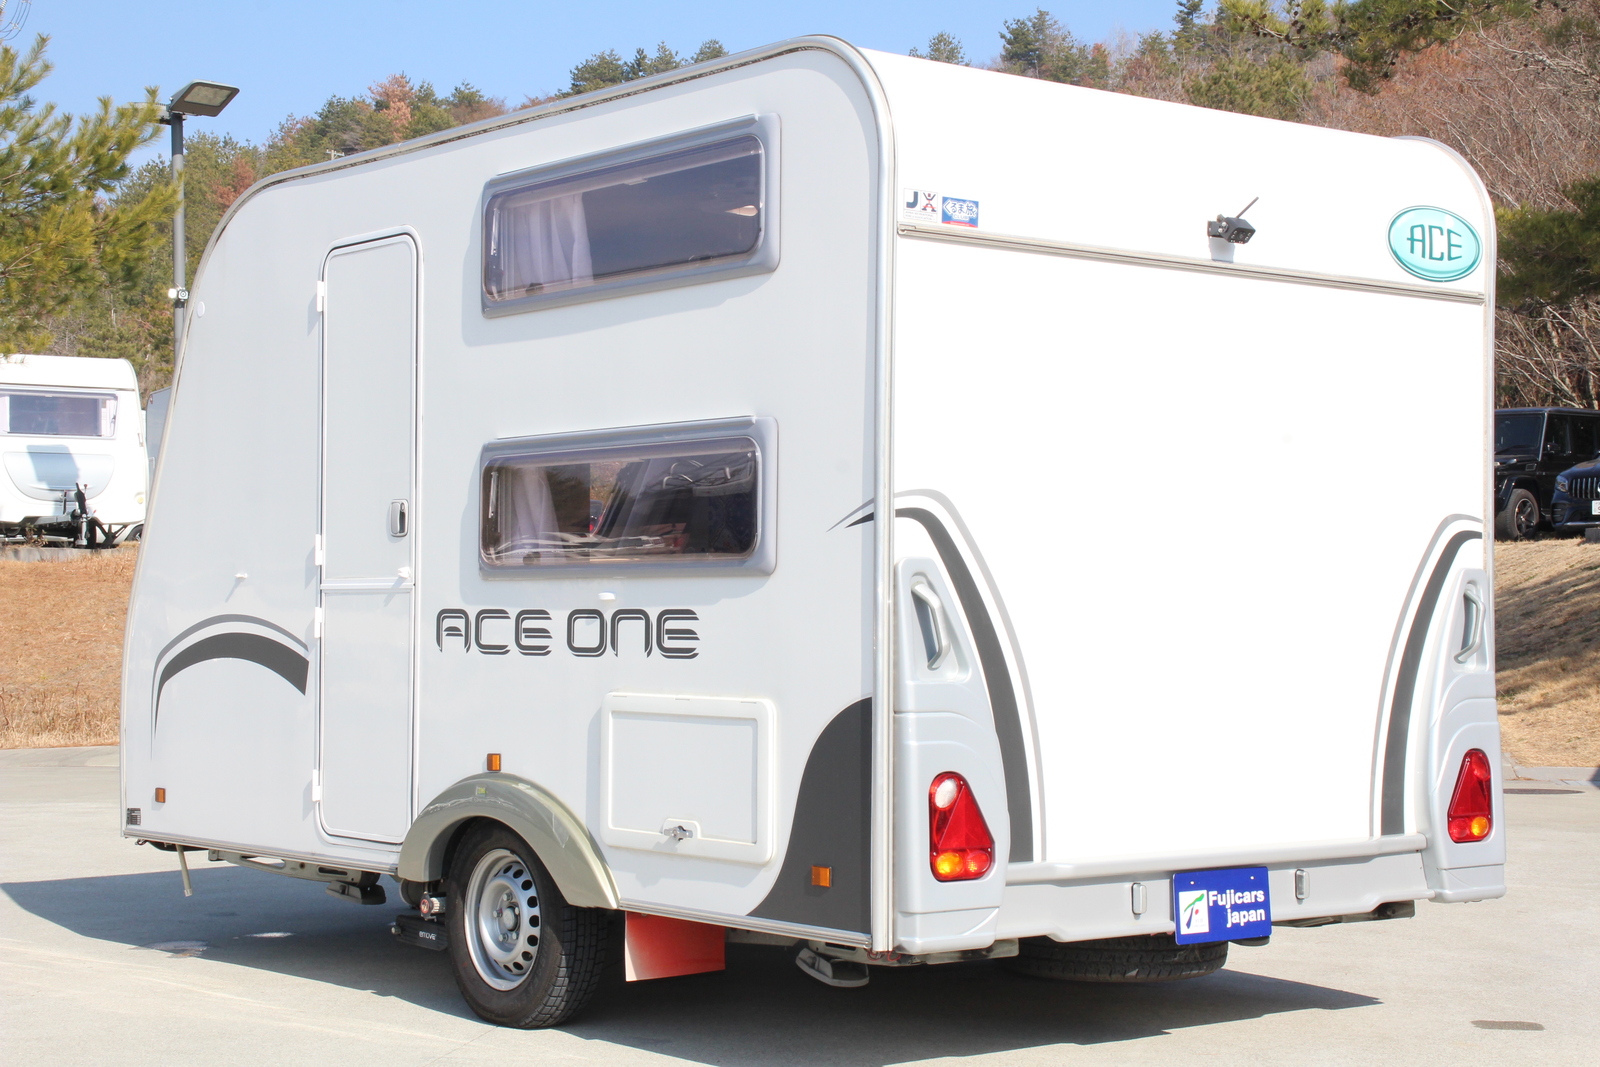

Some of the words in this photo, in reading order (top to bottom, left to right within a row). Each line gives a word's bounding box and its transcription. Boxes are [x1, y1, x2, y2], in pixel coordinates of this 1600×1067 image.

[944, 200, 977, 217] くるま旅
[1407, 224, 1462, 261] ACE
[436, 608, 553, 656] ACE
[567, 608, 700, 659] ONE
[1208, 889, 1265, 908] Fujicars
[1226, 909, 1266, 928] japan
